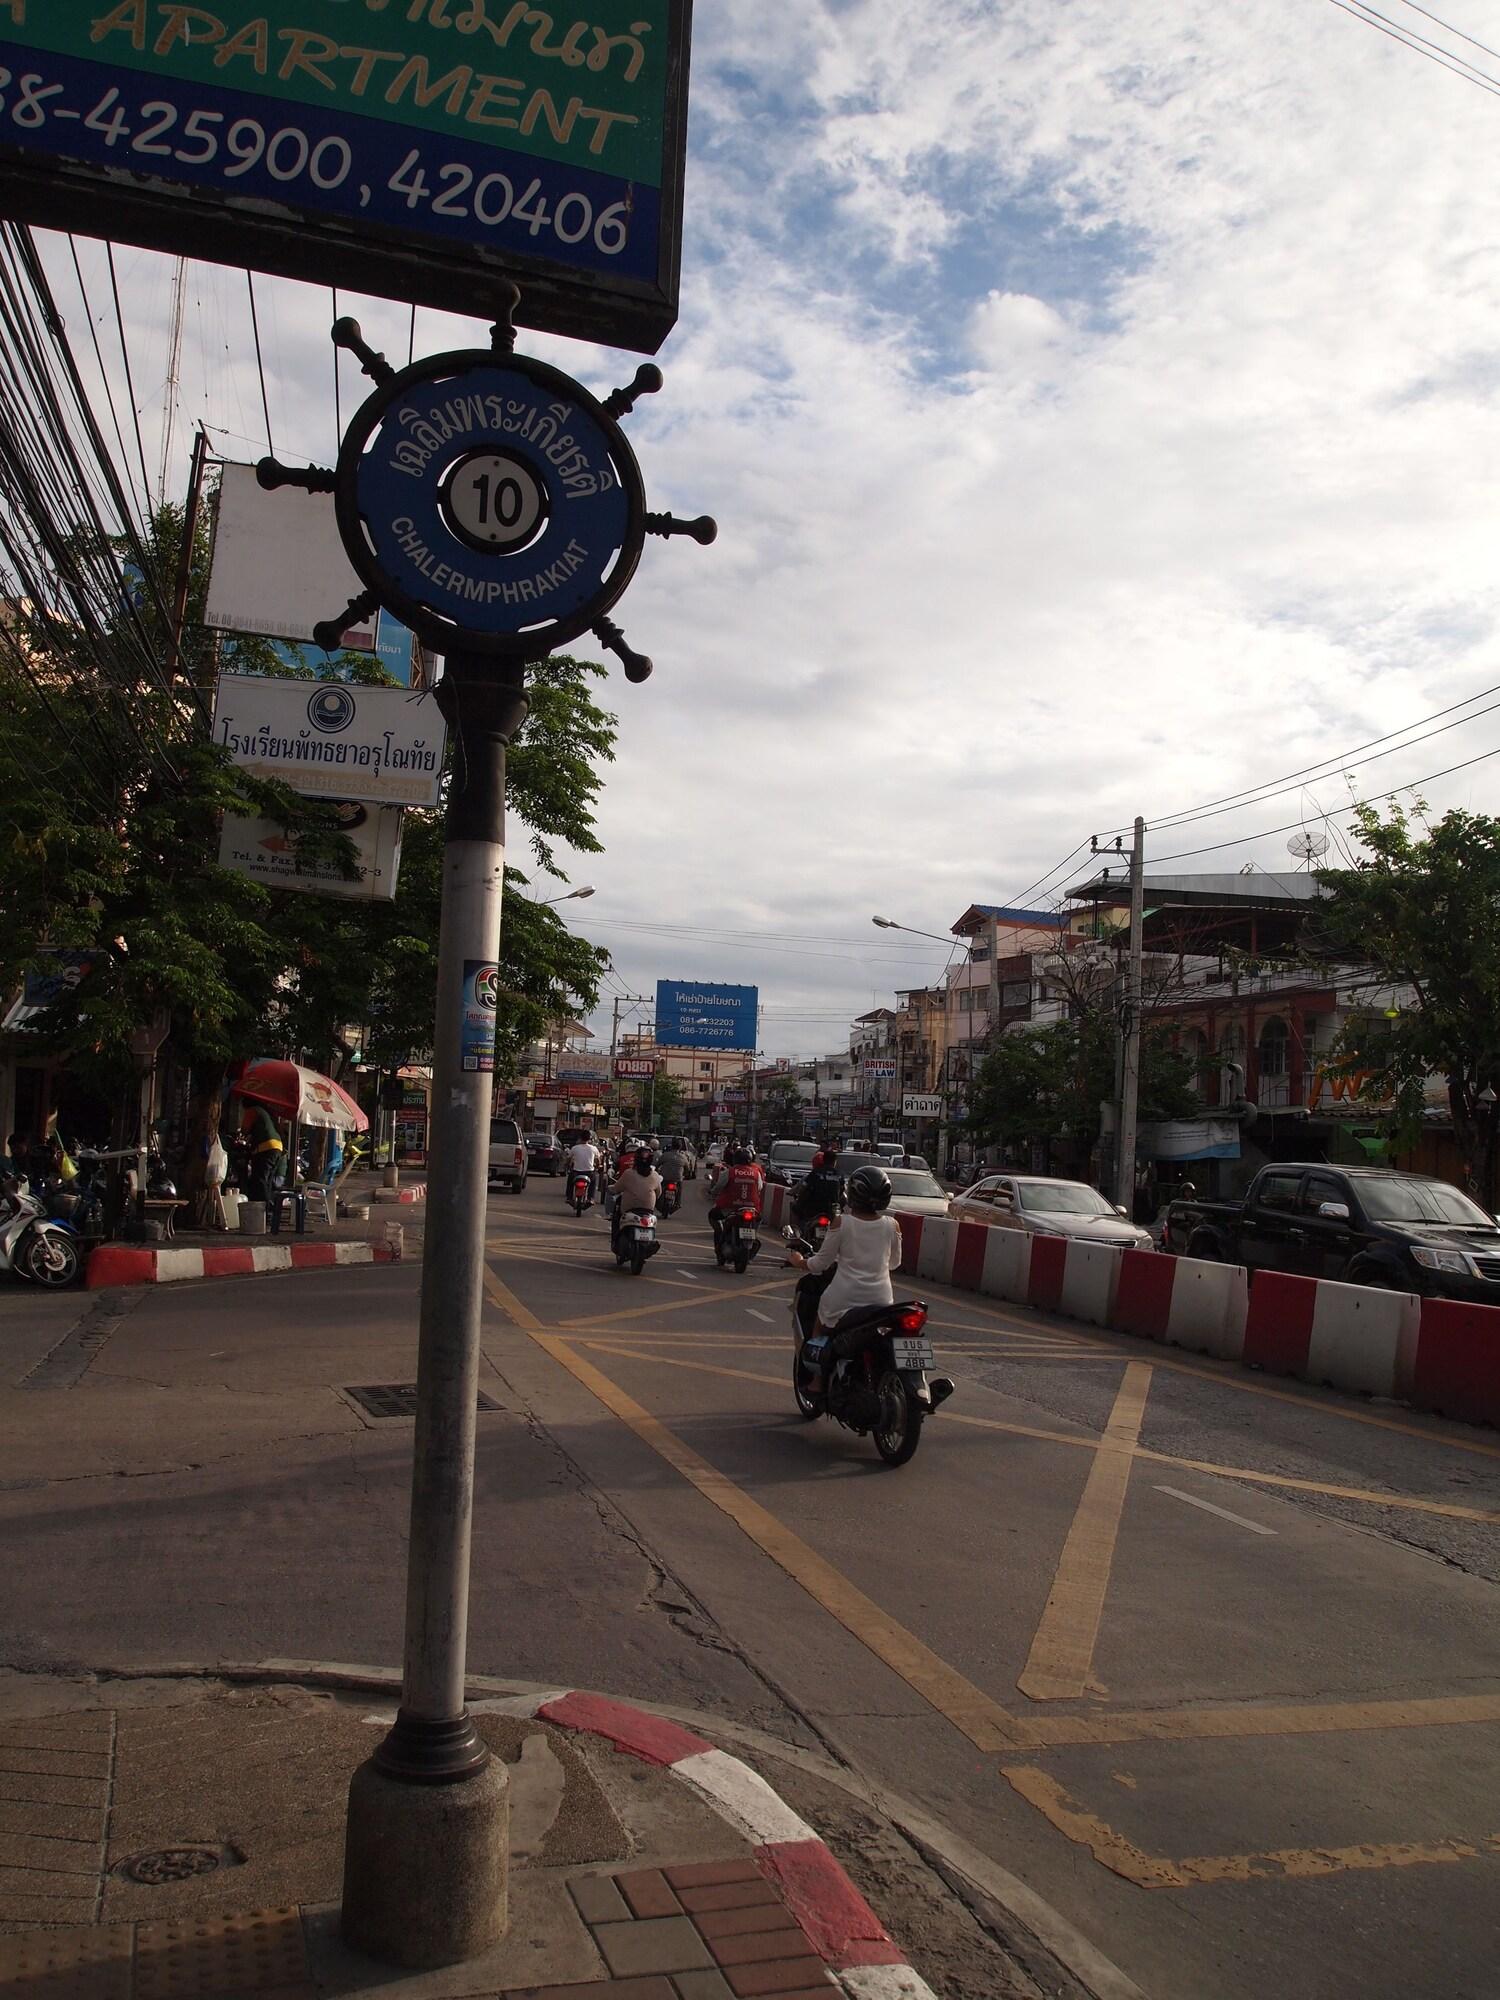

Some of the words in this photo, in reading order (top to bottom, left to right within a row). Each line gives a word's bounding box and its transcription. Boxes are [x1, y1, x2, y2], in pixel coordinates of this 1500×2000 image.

[90, 0, 639, 154] APARTMENT
[388, 149, 627, 255] 420406
[389, 394, 614, 499] เฉลิมพระเกียรติ
[472, 474, 523, 527] 10
[391, 516, 589, 604] CHALERMPHRAKIAT
[232, 850, 253, 861] Tel.
[257, 854, 266, 863] &
[270, 857, 295, 866] Fax.
[864, 1059, 895, 1069] BRITISH
[875, 1069, 895, 1077] LAW
